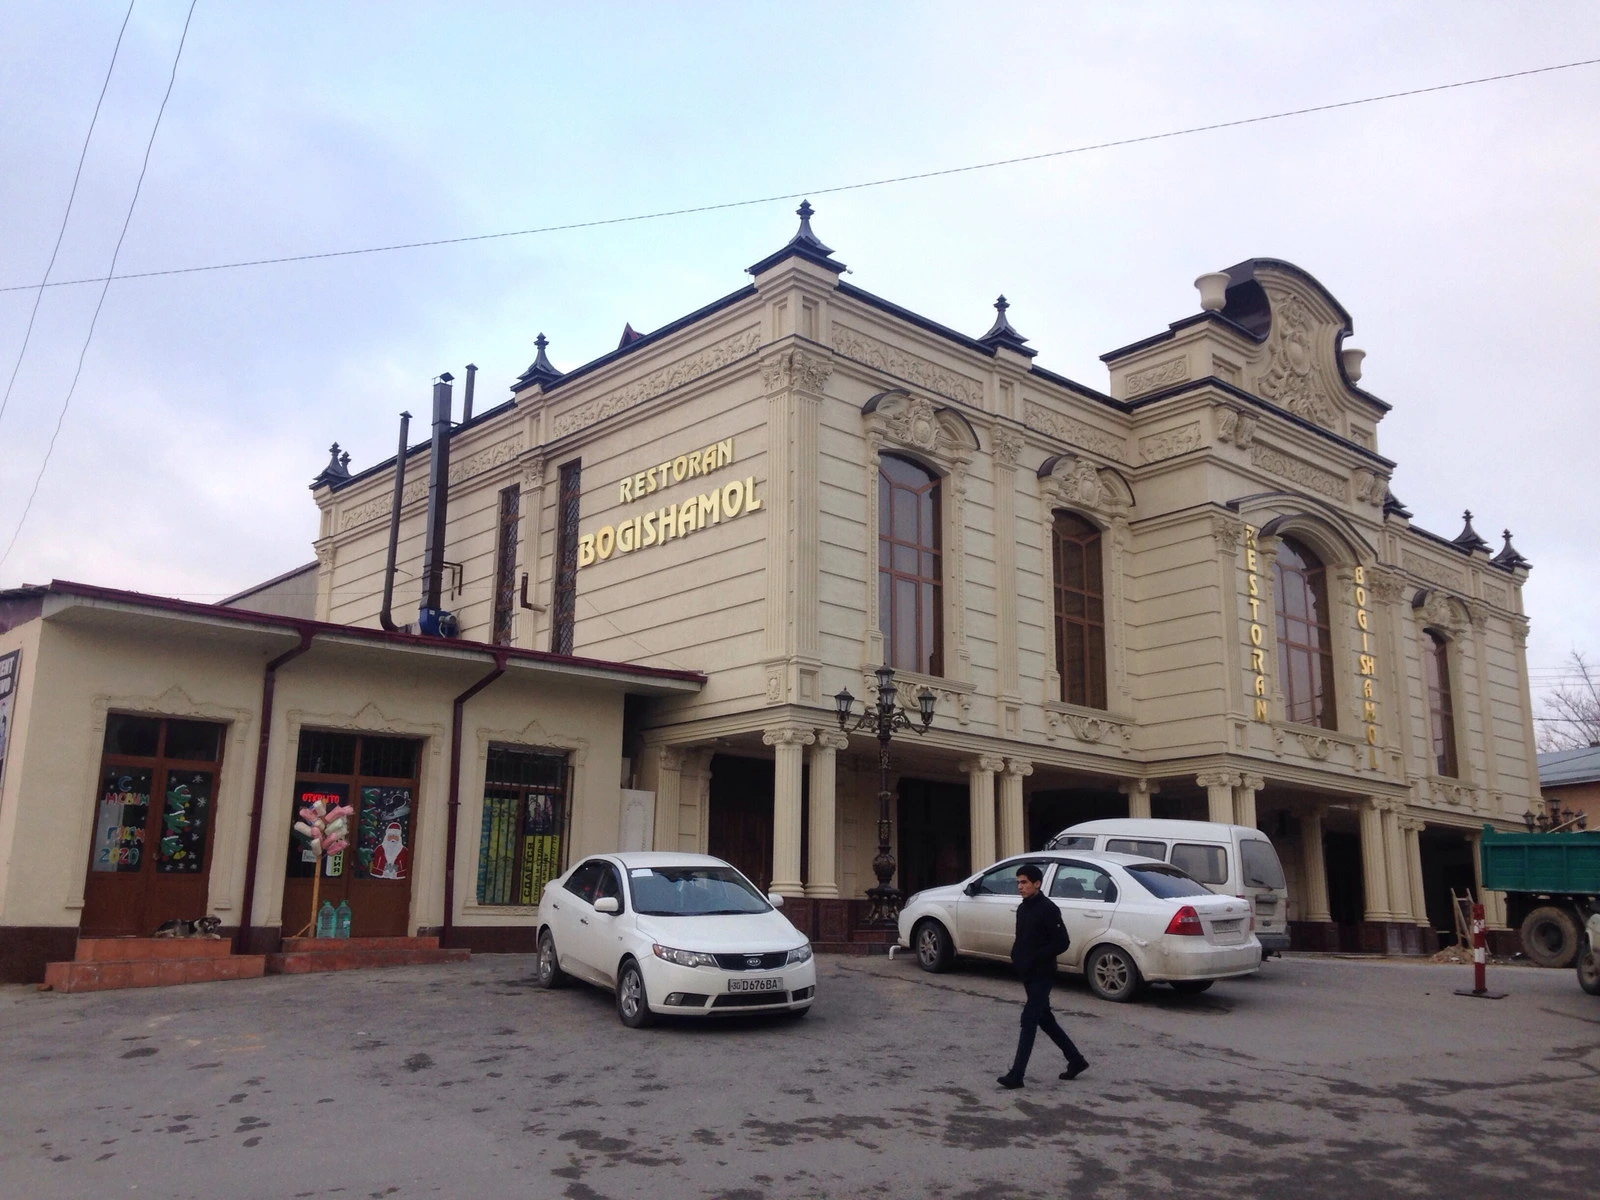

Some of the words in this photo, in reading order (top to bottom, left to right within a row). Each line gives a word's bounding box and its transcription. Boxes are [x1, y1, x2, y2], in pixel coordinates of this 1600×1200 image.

[619, 438, 735, 503] RESTORAN
[579, 476, 763, 568] BOGISHAMOL
[1245, 524, 1268, 723] RESTORAN
[1355, 566, 1379, 770] BOGISHAMOL
[100, 848, 140, 866] 2020
